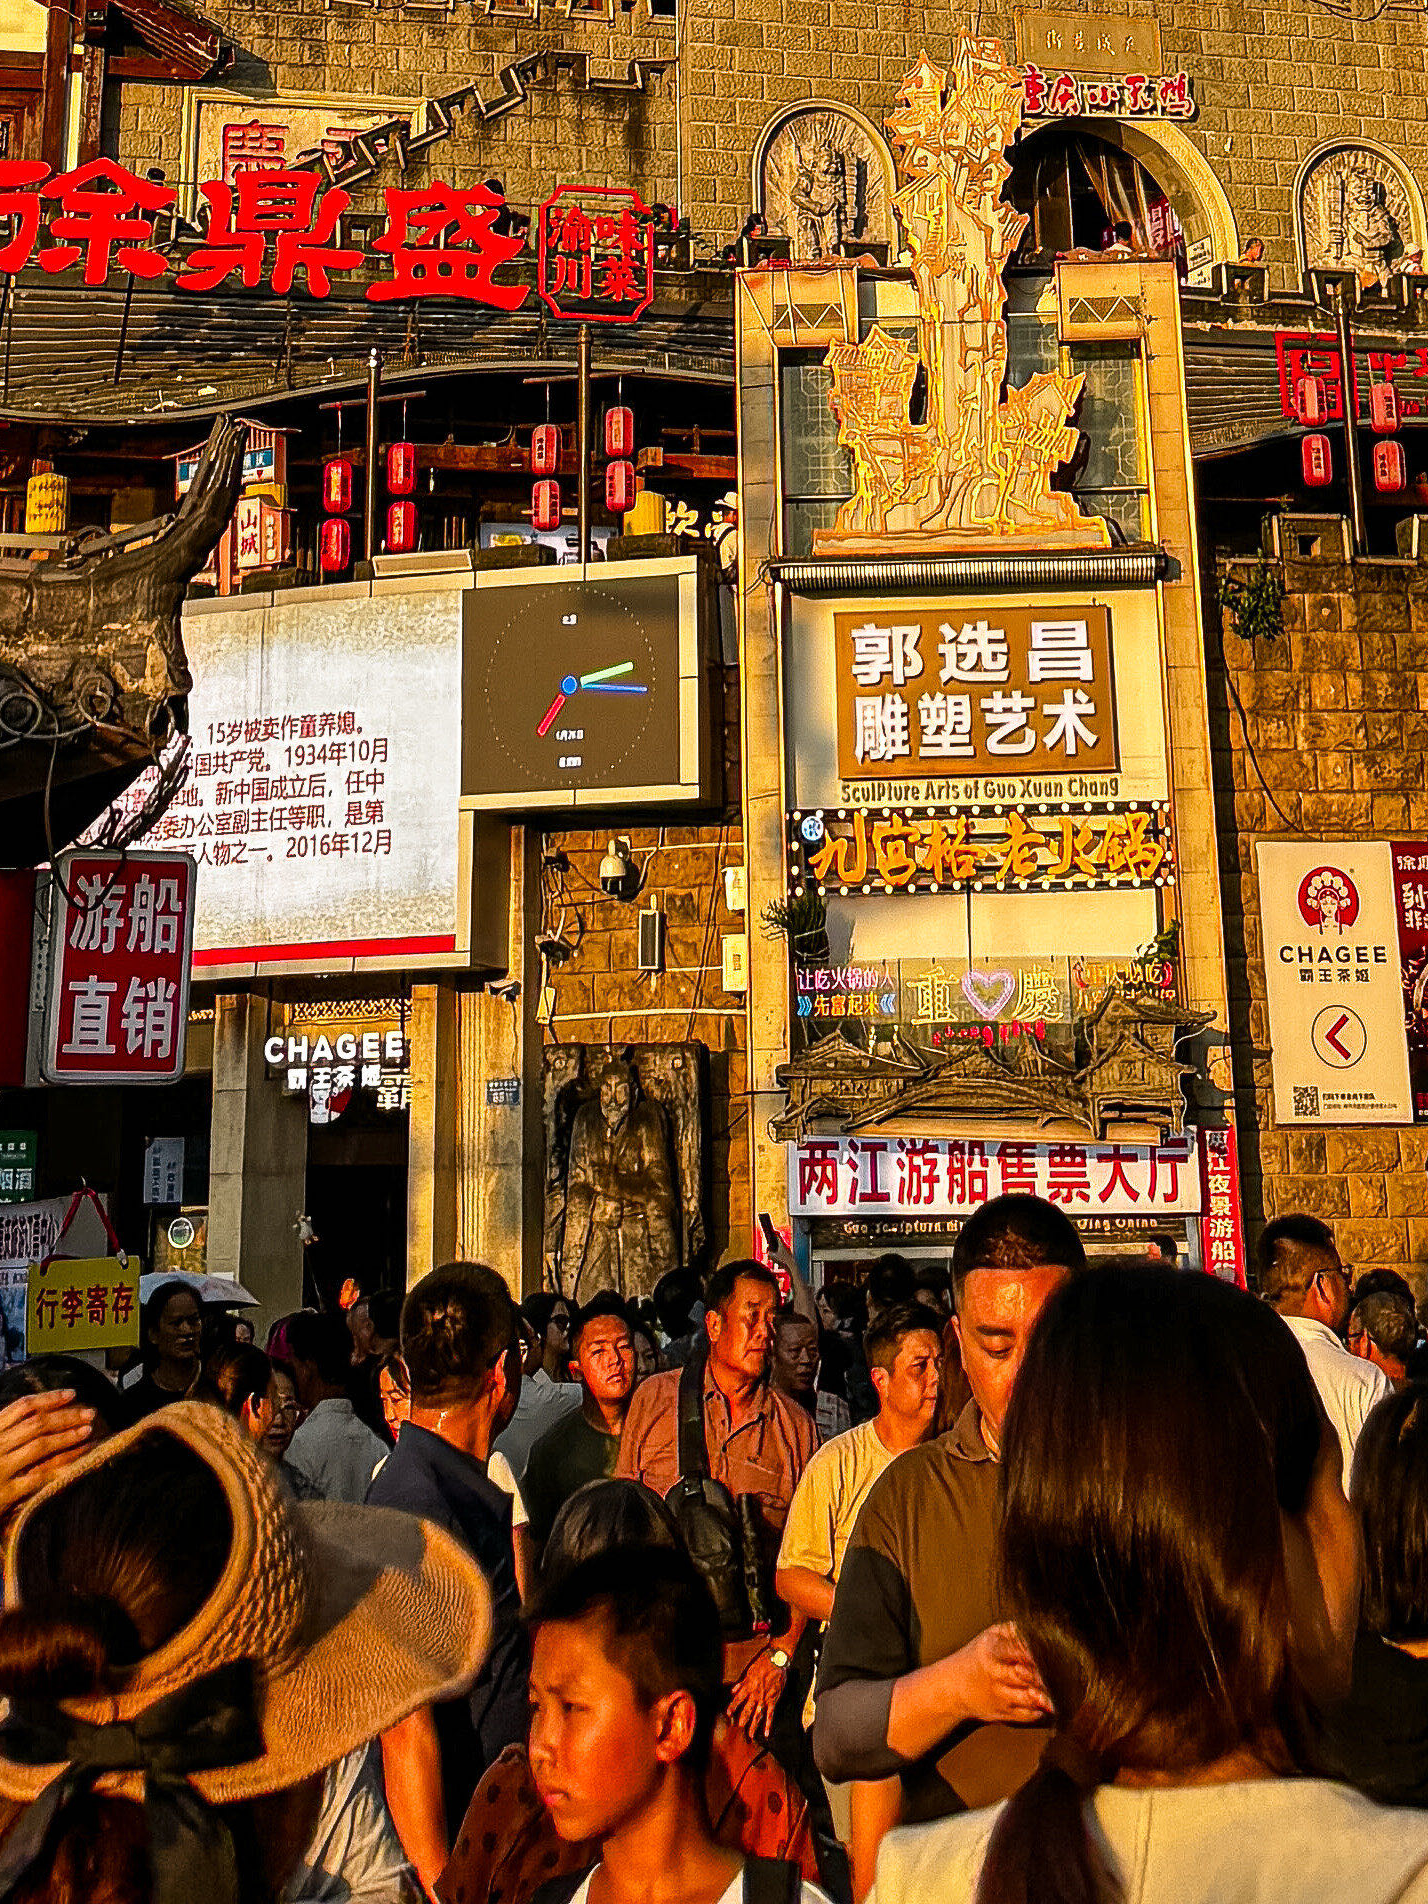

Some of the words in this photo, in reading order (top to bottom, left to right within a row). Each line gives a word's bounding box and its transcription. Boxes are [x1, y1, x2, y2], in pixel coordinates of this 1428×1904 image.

[551, 254, 644, 305] 川菜
[852, 620, 1094, 682] 郭选昌
[855, 690, 1098, 758] 雕塑艺术
[70, 873, 184, 950] 游船
[1268, 943, 1384, 963] CHAGEE
[62, 974, 176, 1057] 直销
[264, 1034, 405, 1060] CHAGEE
[801, 1136, 1202, 1203] 两江游船售票大厅
[36, 1285, 134, 1328] 行李寄存
